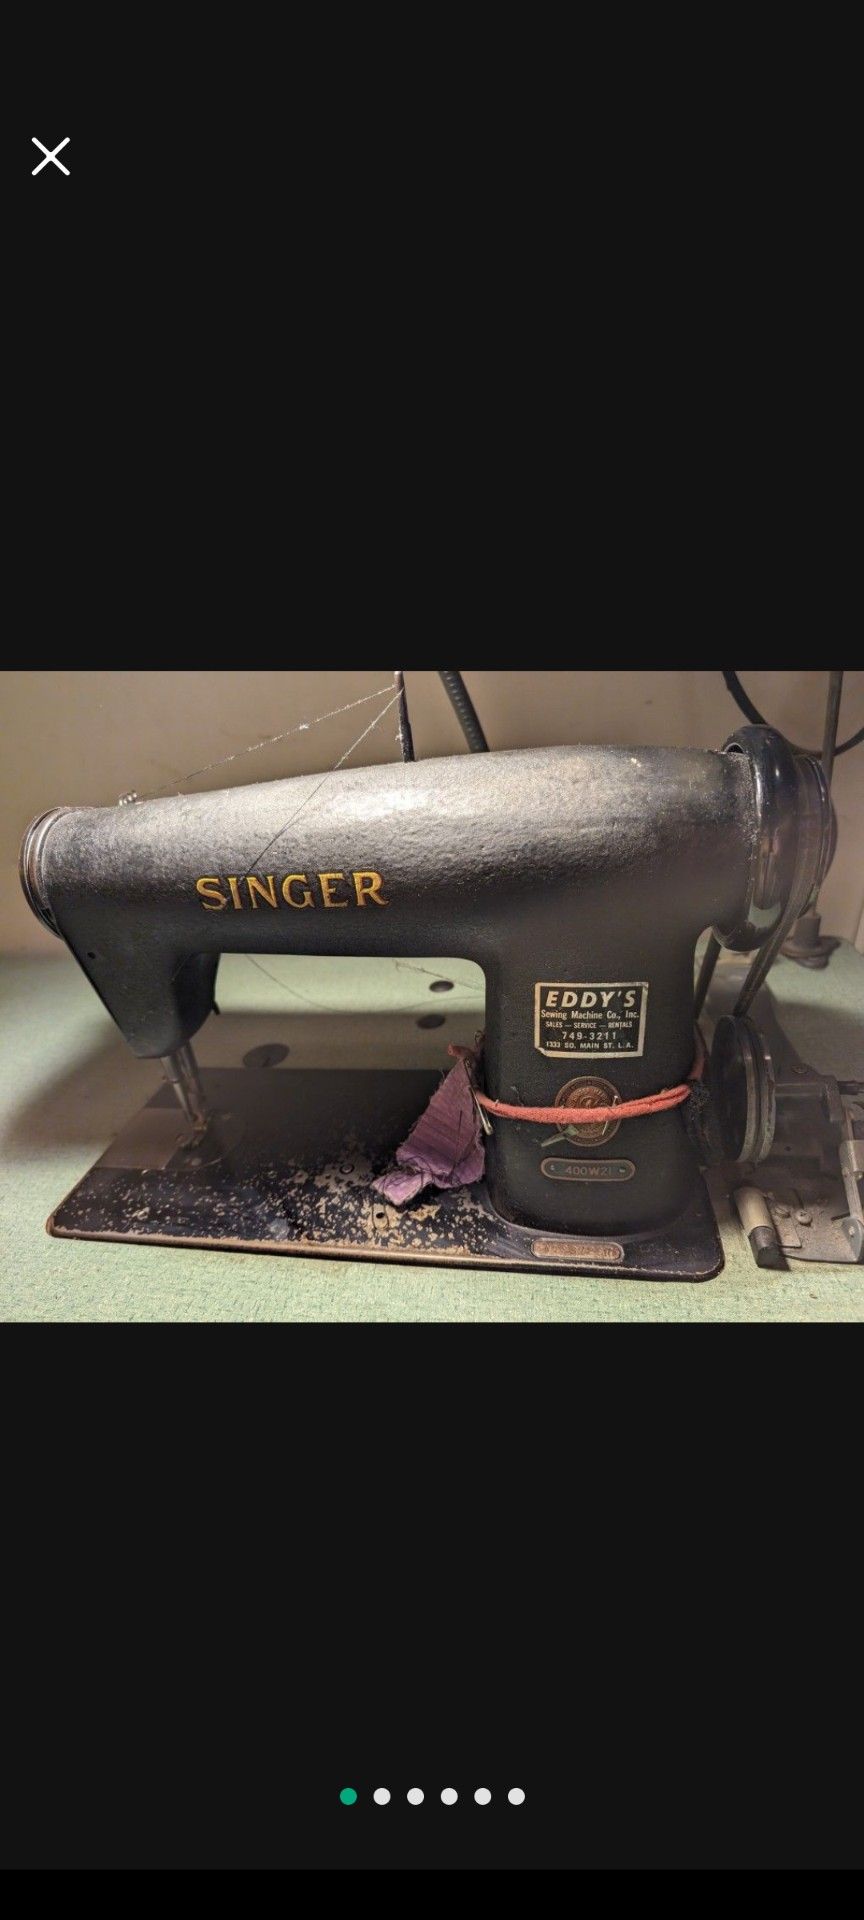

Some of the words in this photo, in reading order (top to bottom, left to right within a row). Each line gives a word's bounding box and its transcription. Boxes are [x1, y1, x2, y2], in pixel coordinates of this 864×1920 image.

[196, 871, 390, 911] SINGER
[545, 990, 636, 1008] EDDY'S
[541, 1009, 567, 1020] Sewing
[571, 1010, 603, 1020] Machine
[625, 1009, 640, 1018] Inc.
[608, 1021, 633, 1029] RENTALS
[562, 1031, 617, 1040] 749-3211
